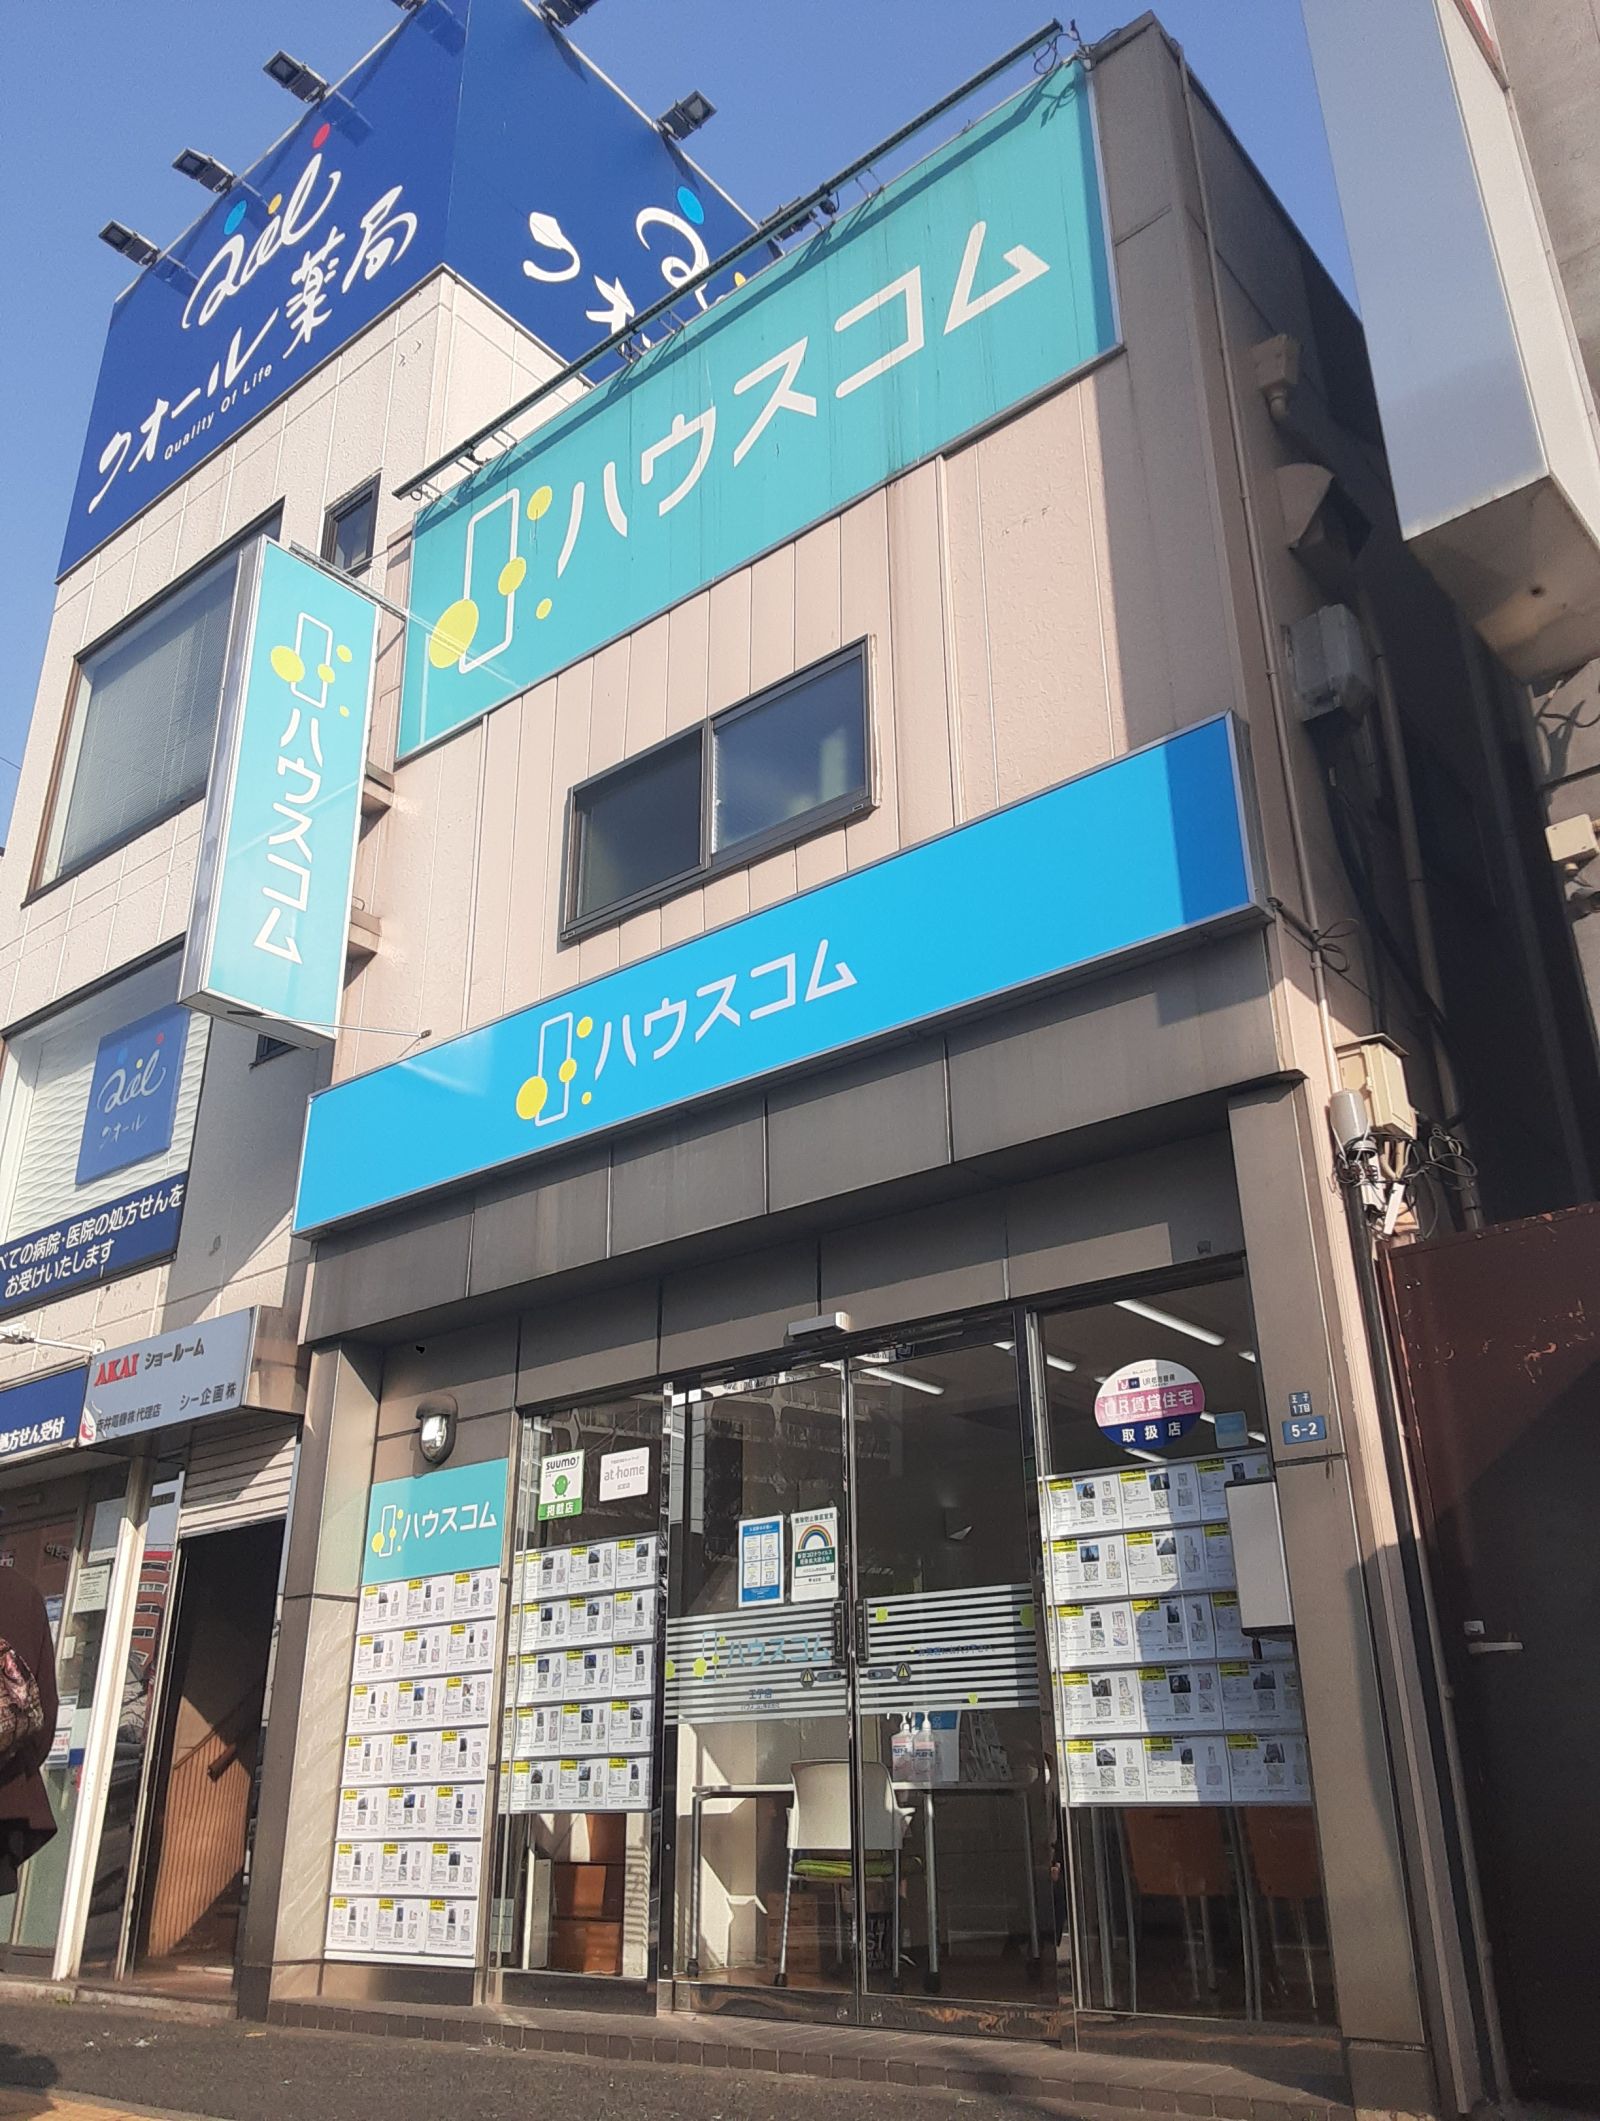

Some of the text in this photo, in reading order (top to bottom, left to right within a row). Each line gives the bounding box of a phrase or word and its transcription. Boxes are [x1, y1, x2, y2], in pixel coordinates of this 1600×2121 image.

[89, 186, 417, 514] クオール薬局
[165, 364, 272, 460] Quality Of Life
[557, 221, 1050, 577] ハウスコム
[253, 708, 324, 965] ハウスコム
[595, 939, 857, 1080] ハウスコム
[5, 1239, 115, 1298] お受けいたします
[94, 1338, 204, 1387] AKAI ショールーム
[1103, 1389, 1194, 1417] UR賃貸住宅
[1292, 1403, 1311, 1414] 1丁目
[1122, 1422, 1182, 1443] 取扱店
[1291, 1422, 1318, 1438] 5-2
[402, 1501, 497, 1541] ハウスコム
[728, 1634, 831, 1667] ハウスコム
